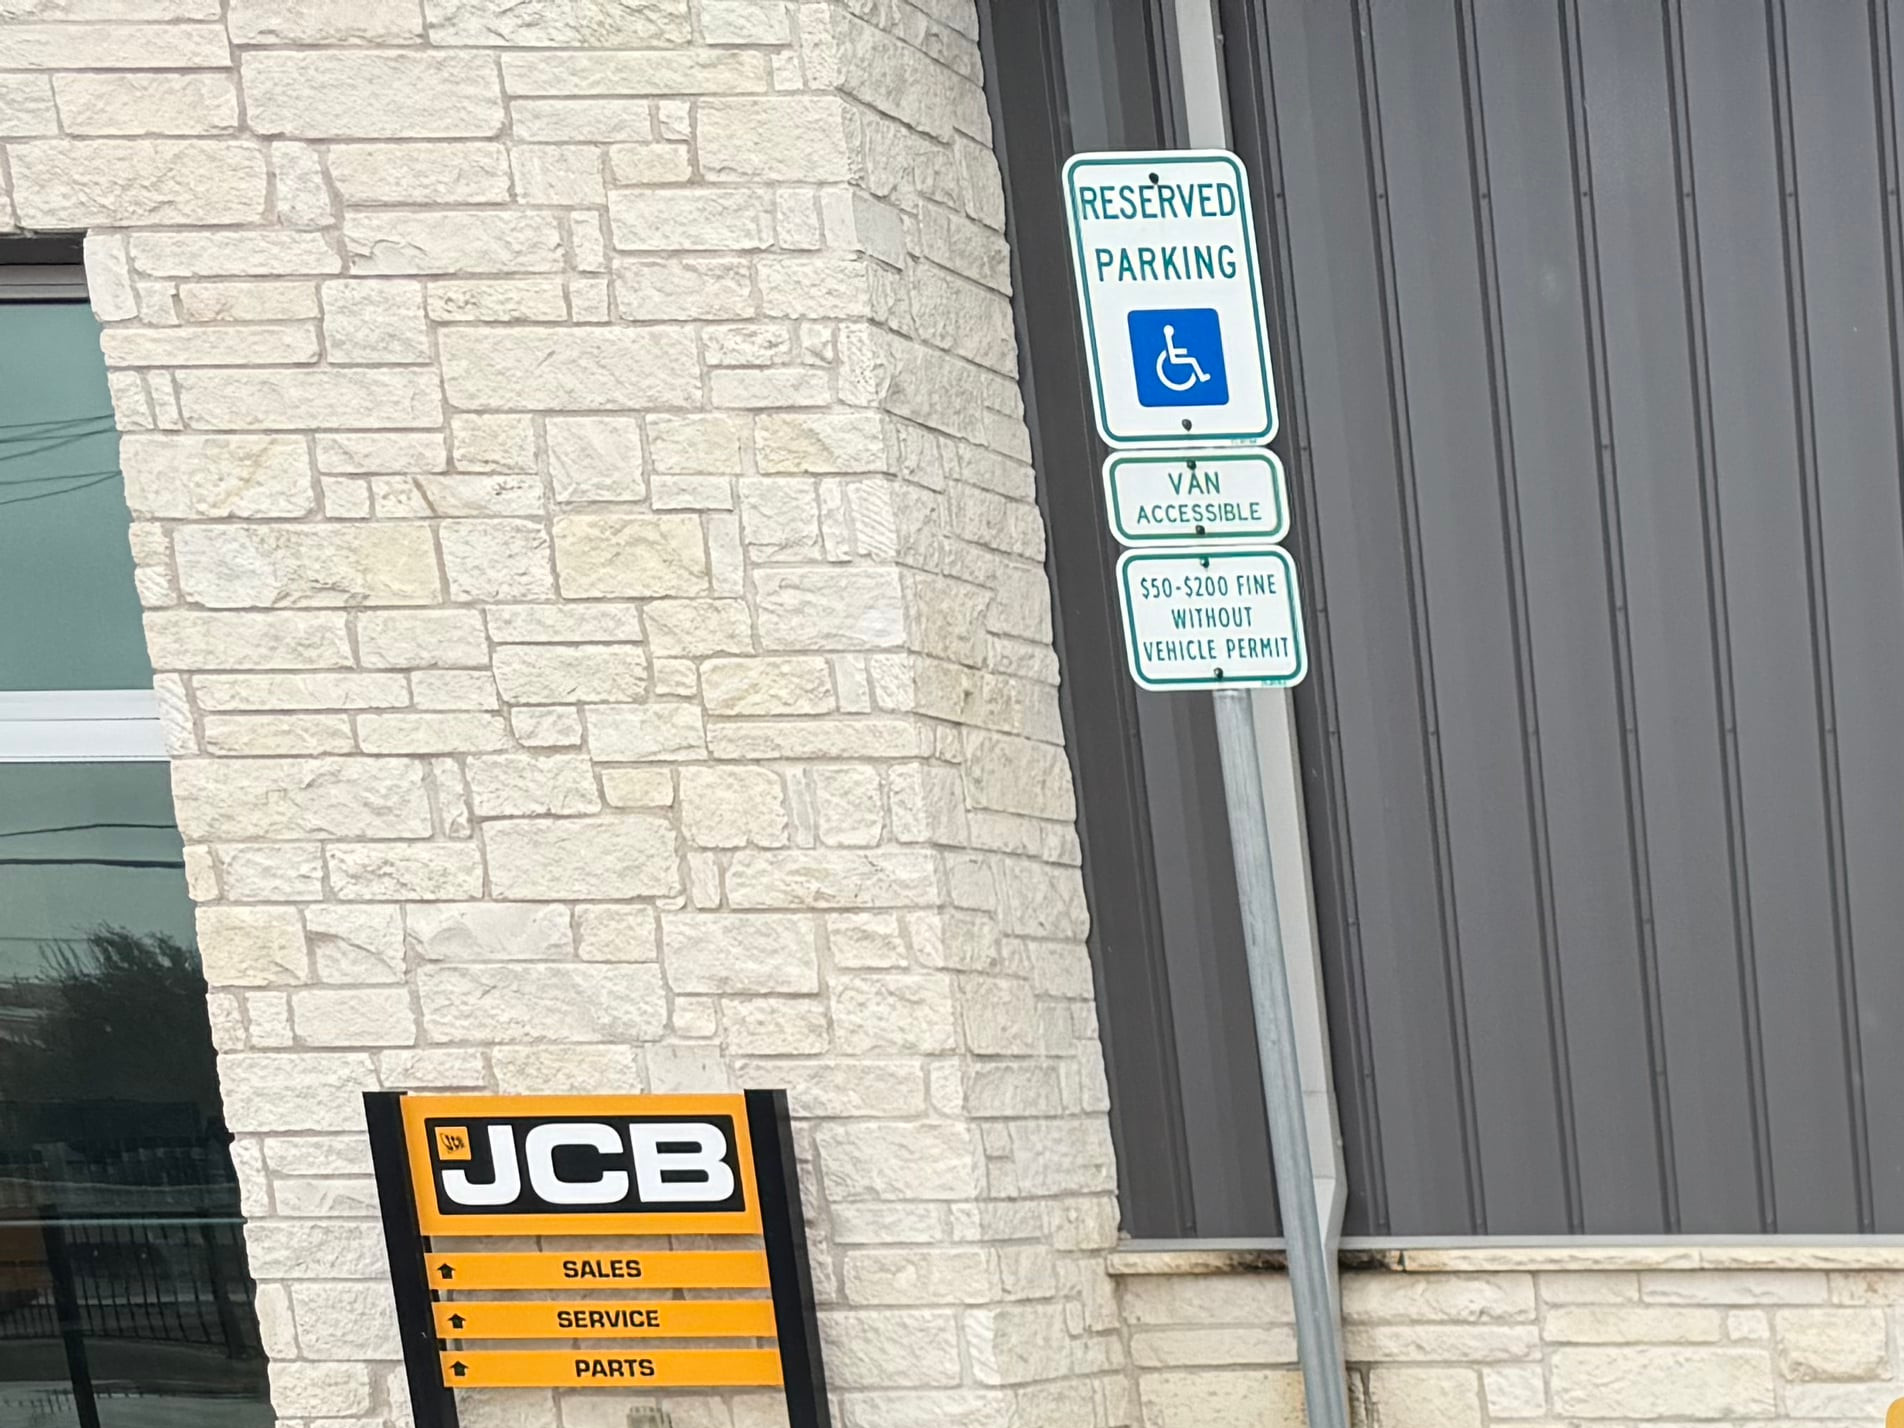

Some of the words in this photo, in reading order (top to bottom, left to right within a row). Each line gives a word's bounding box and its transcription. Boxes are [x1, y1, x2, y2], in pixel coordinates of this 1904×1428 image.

[1079, 183, 1237, 221] RESERVED
[1095, 244, 1238, 282] PARKING
[1168, 470, 1221, 496] VAN
[1135, 502, 1264, 525] ACCESSIBLE
[1139, 575, 1229, 600] $50-$200
[1235, 573, 1279, 597] FINE
[1170, 605, 1254, 630] WITHOUT
[1142, 638, 1218, 664] VEHICLE
[1225, 634, 1291, 660] PERMIT
[441, 1122, 736, 1206] JCB
[562, 1259, 643, 1280] SALES
[556, 1308, 661, 1330] SERVICE
[574, 1358, 656, 1379] PARTS
